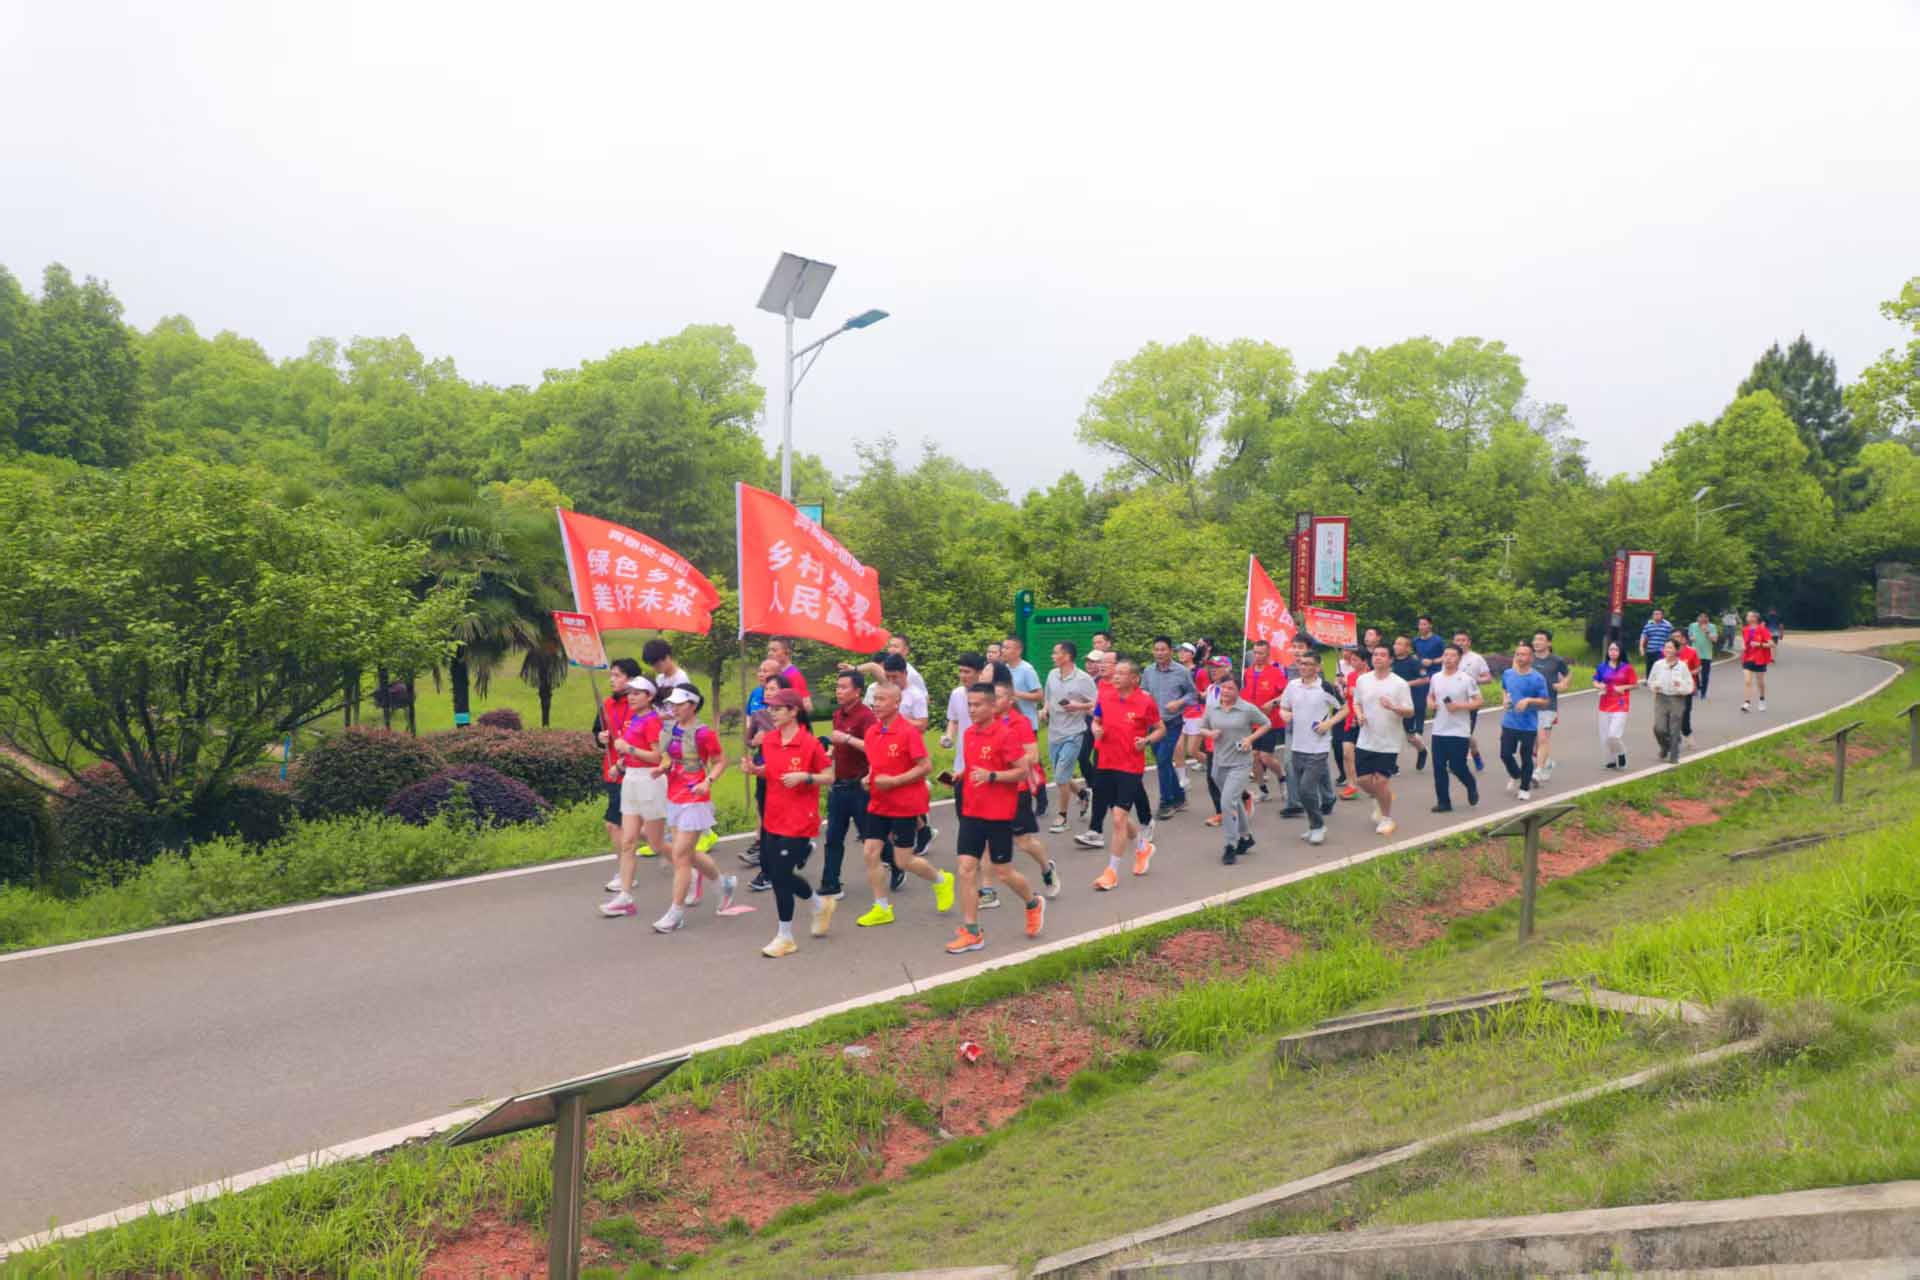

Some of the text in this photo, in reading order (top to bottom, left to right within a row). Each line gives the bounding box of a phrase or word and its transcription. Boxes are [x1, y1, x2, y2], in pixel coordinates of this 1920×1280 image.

[587, 549, 698, 598] 绿色乡村
[592, 583, 693, 617] 美好未来
